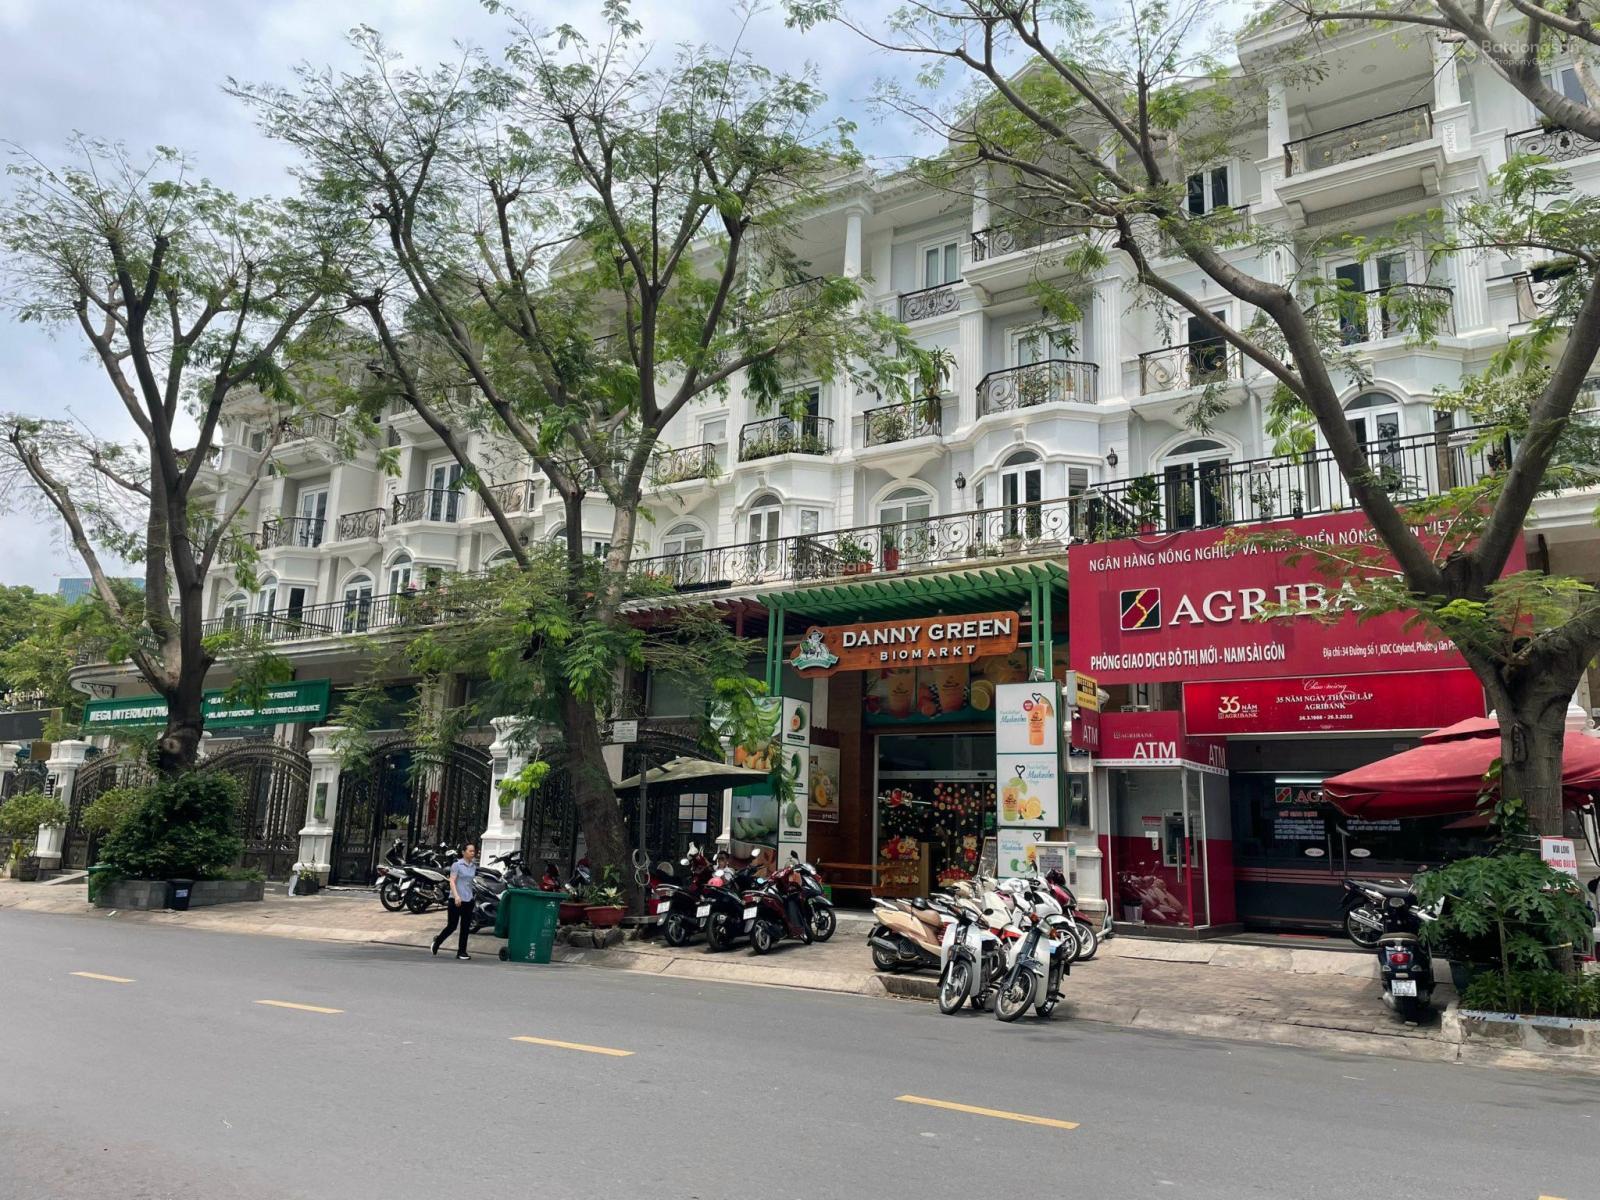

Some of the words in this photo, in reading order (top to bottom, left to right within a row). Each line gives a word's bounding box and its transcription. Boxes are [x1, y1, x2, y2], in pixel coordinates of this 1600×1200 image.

[1089, 555, 1121, 572] NGÂN
[1123, 552, 1156, 569] HÀNG
[1158, 548, 1191, 564] NÔNG
[1339, 527, 1377, 546] NÔNG
[842, 625, 921, 648] DANNY
[928, 617, 1012, 641] GREEN
[879, 644, 976, 662] BIOMARKT
[1090, 652, 1121, 671] PHÒNG
[1121, 652, 1145, 669] GIAO
[1145, 651, 1167, 669] DỊCH
[1167, 647, 1182, 666] ĐÔ
[1182, 649, 1199, 668] THỊ
[1199, 644, 1218, 664] MỚI
[1224, 646, 1246, 663] NAM
[1247, 641, 1263, 662] SÀI
[1263, 640, 1286, 661] GÒN
[1218, 695, 1241, 714] 35
[1276, 696, 1285, 704] 35
[1285, 694, 1303, 703] NĂM
[1304, 693, 1327, 702] NGÀY
[1304, 702, 1347, 711] AGRIBANK
[89, 710, 112, 722] MEGA
[1082, 724, 1098, 745] ATM
[1133, 741, 1177, 759] ATM
[1208, 743, 1226, 768] ATM
